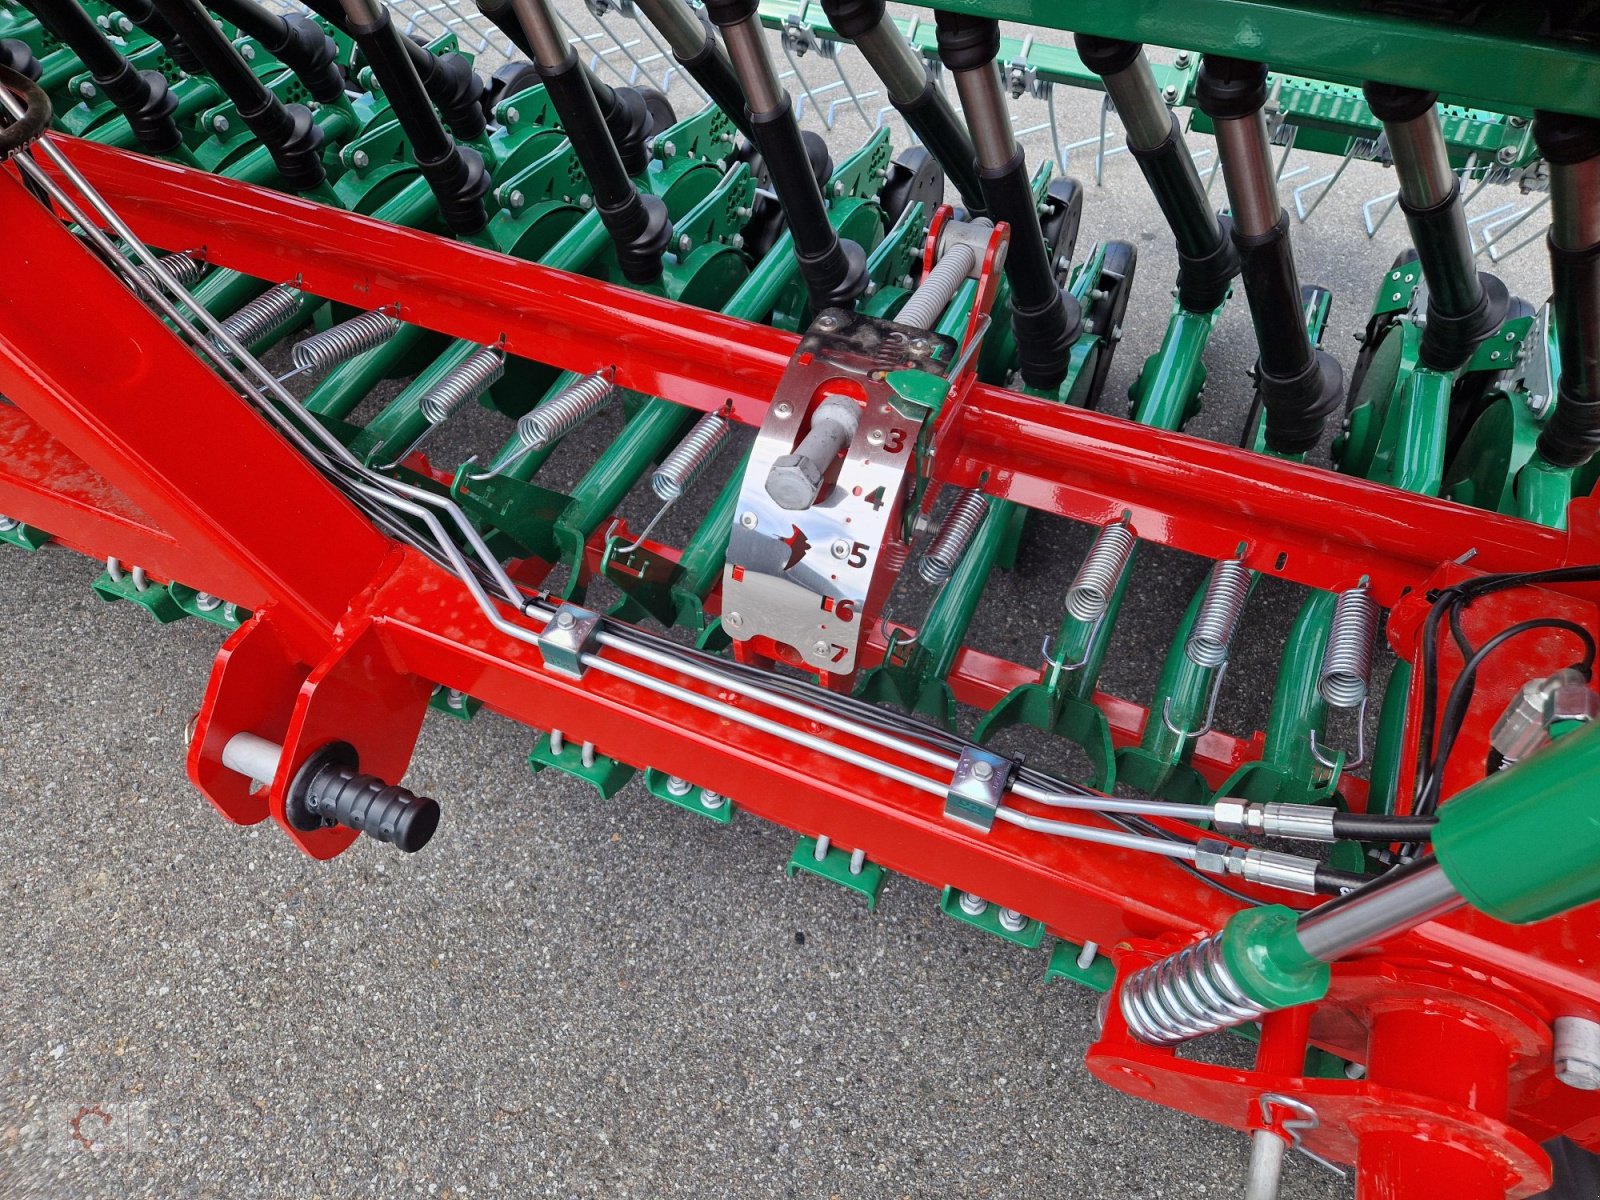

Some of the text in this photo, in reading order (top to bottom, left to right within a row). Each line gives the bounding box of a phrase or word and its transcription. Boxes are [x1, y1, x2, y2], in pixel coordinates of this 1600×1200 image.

[930, 344, 945, 361] 1
[883, 428, 907, 454] 3
[864, 486, 886, 512] 4
[848, 541, 870, 569] 5
[835, 599, 855, 622] 6
[831, 643, 849, 663] 7
